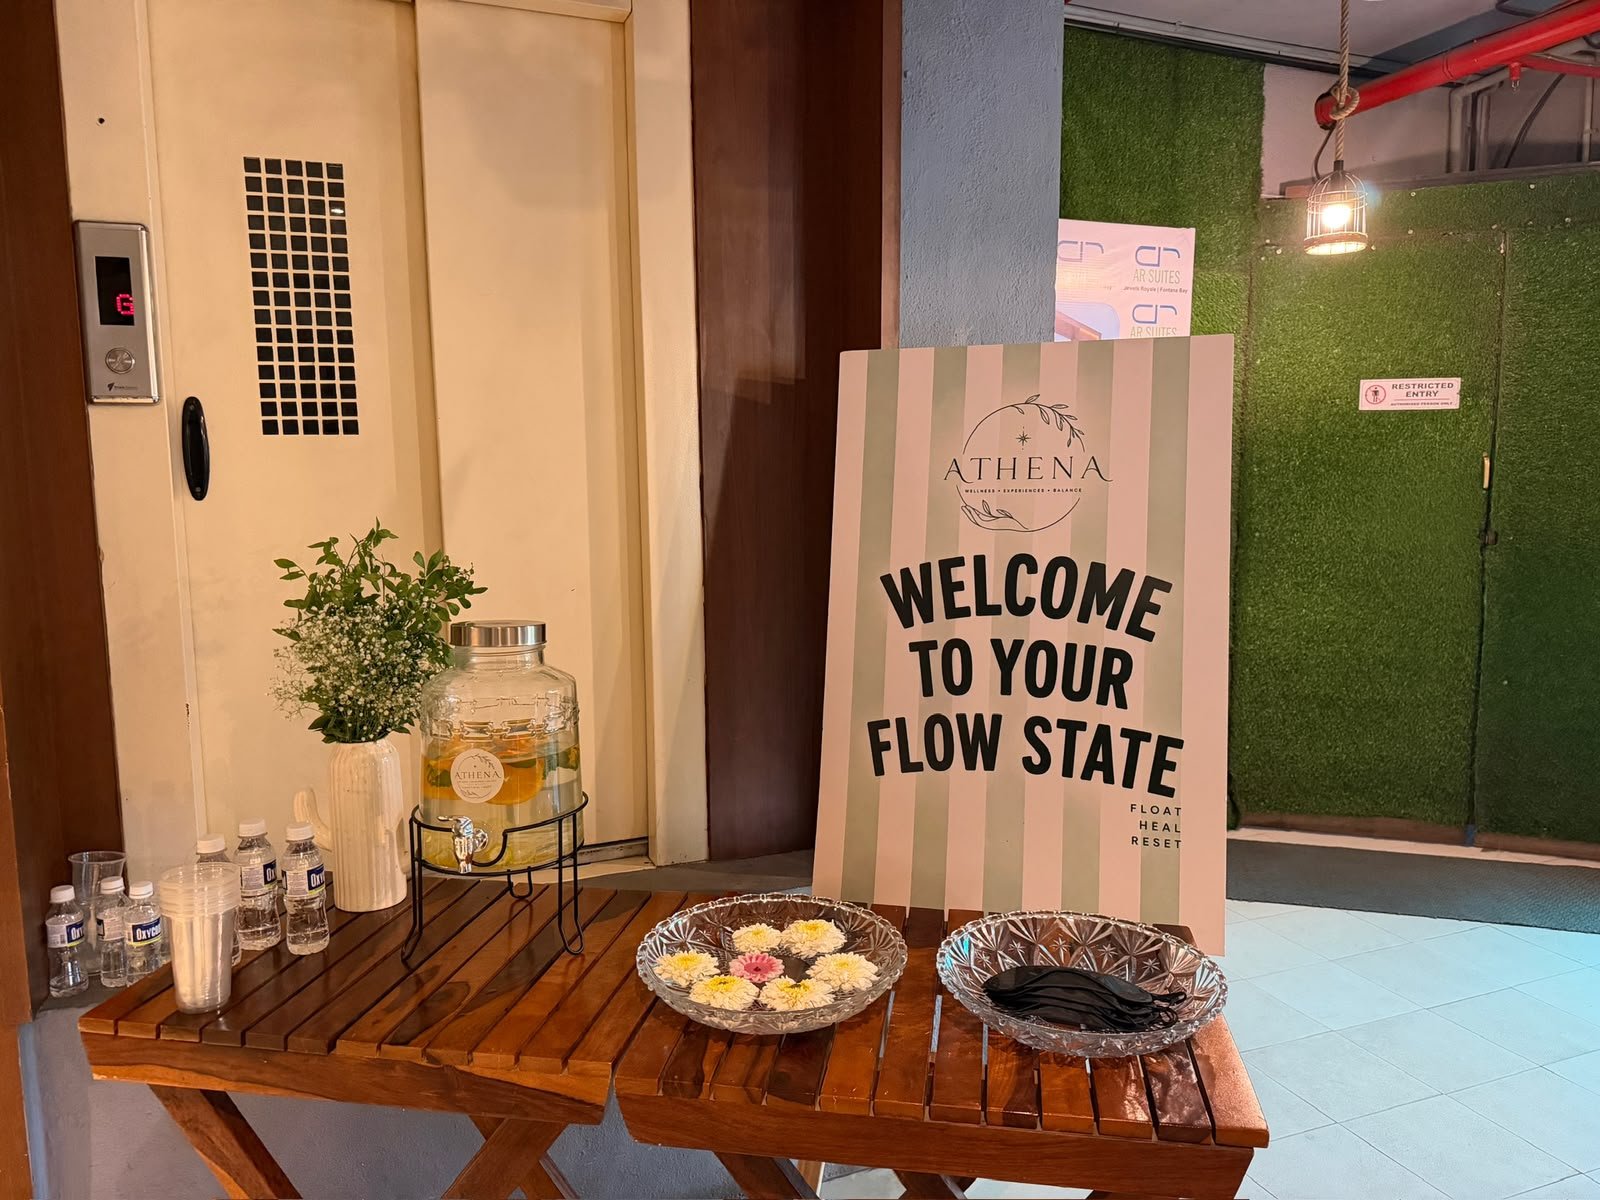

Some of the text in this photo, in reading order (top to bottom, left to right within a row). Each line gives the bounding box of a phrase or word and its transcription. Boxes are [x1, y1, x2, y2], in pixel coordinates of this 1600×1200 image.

[1133, 269, 1181, 284] AR SUITES
[116, 293, 135, 315] G
[1130, 326, 1177, 337] AR SUITES
[1391, 382, 1454, 390] RESTRICTED
[1405, 390, 1439, 398] ENTRY
[944, 455, 1113, 484] ATHENA
[880, 553, 1173, 642] WELCOME
[909, 638, 1134, 710] TO YOUR
[867, 713, 1185, 799] FLOW STATE
[455, 770, 501, 780] ATHENA
[1130, 803, 1182, 816] FLOAT
[1139, 820, 1181, 833] HEAL
[1131, 836, 1182, 849] RESET
